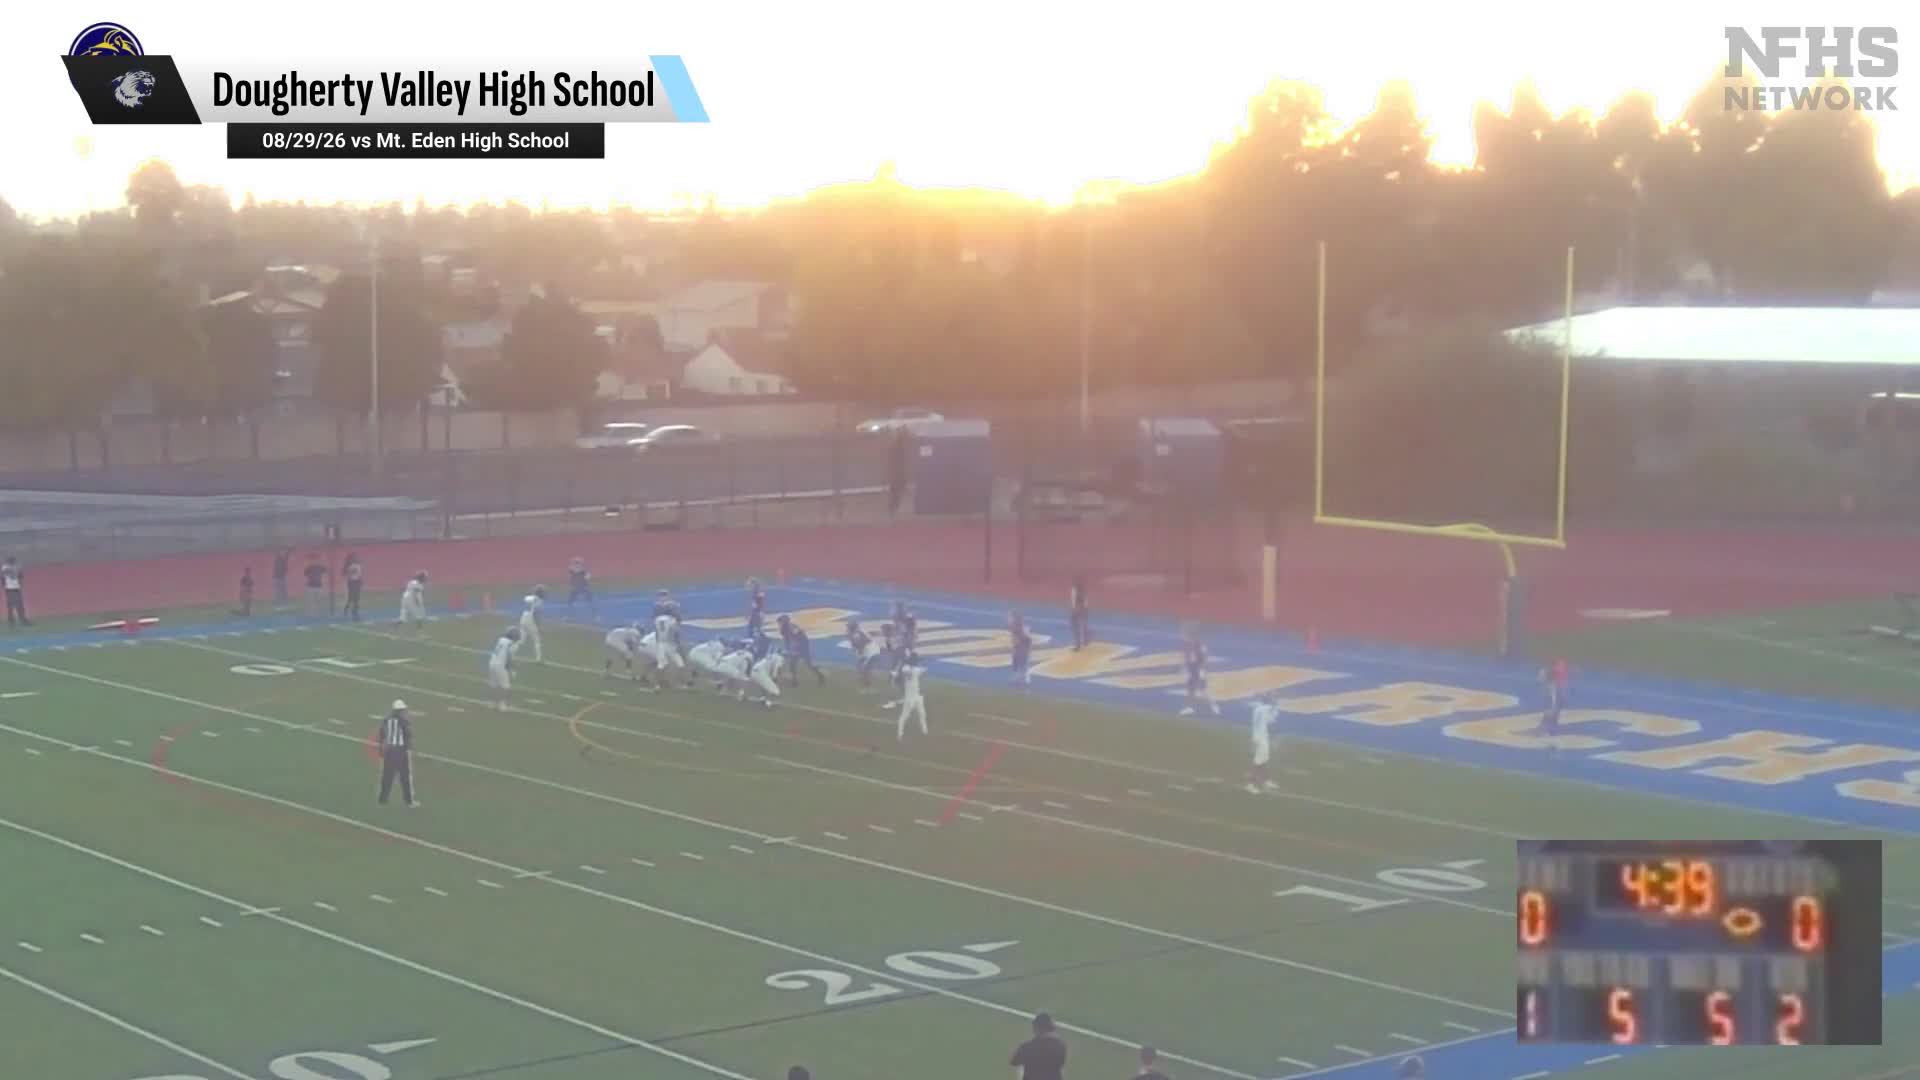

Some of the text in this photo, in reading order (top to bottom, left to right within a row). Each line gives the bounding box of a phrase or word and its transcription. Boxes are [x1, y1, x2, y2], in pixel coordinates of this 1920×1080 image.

[1272, 868, 1488, 912] 10
[1621, 862, 1714, 915] 4:39
[1518, 891, 1547, 944] 0
[1791, 895, 1820, 950] 0
[765, 951, 1001, 1005] 20
[1609, 988, 1636, 1044] 5
[1706, 991, 1734, 1045] 5
[1776, 994, 1803, 1045] 2
